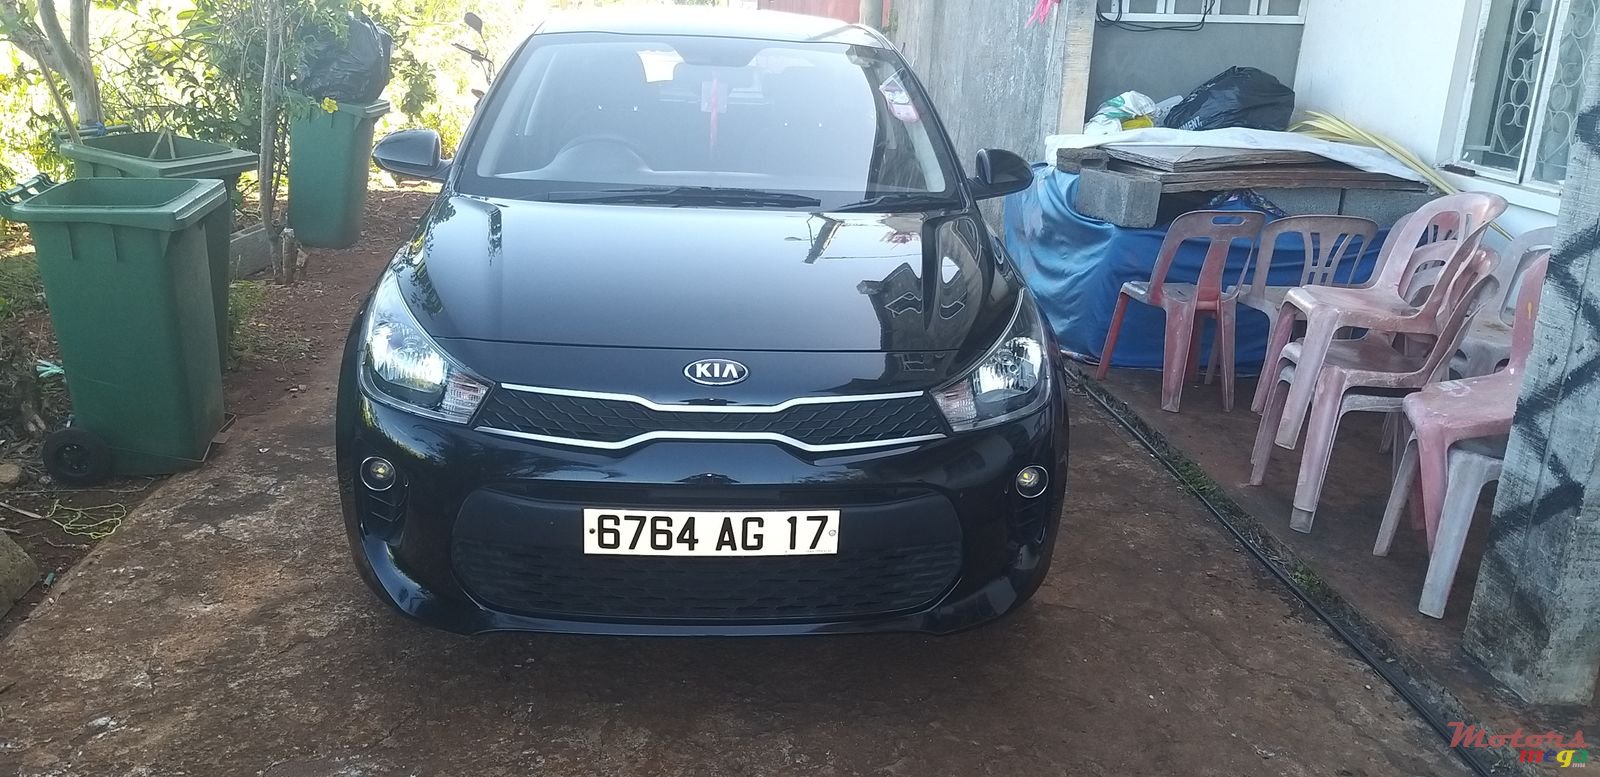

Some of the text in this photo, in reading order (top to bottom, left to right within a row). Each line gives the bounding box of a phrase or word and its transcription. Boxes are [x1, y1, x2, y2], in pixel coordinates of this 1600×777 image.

[695, 363, 739, 379] KIA
[597, 514, 829, 551] 6764 AG 17
